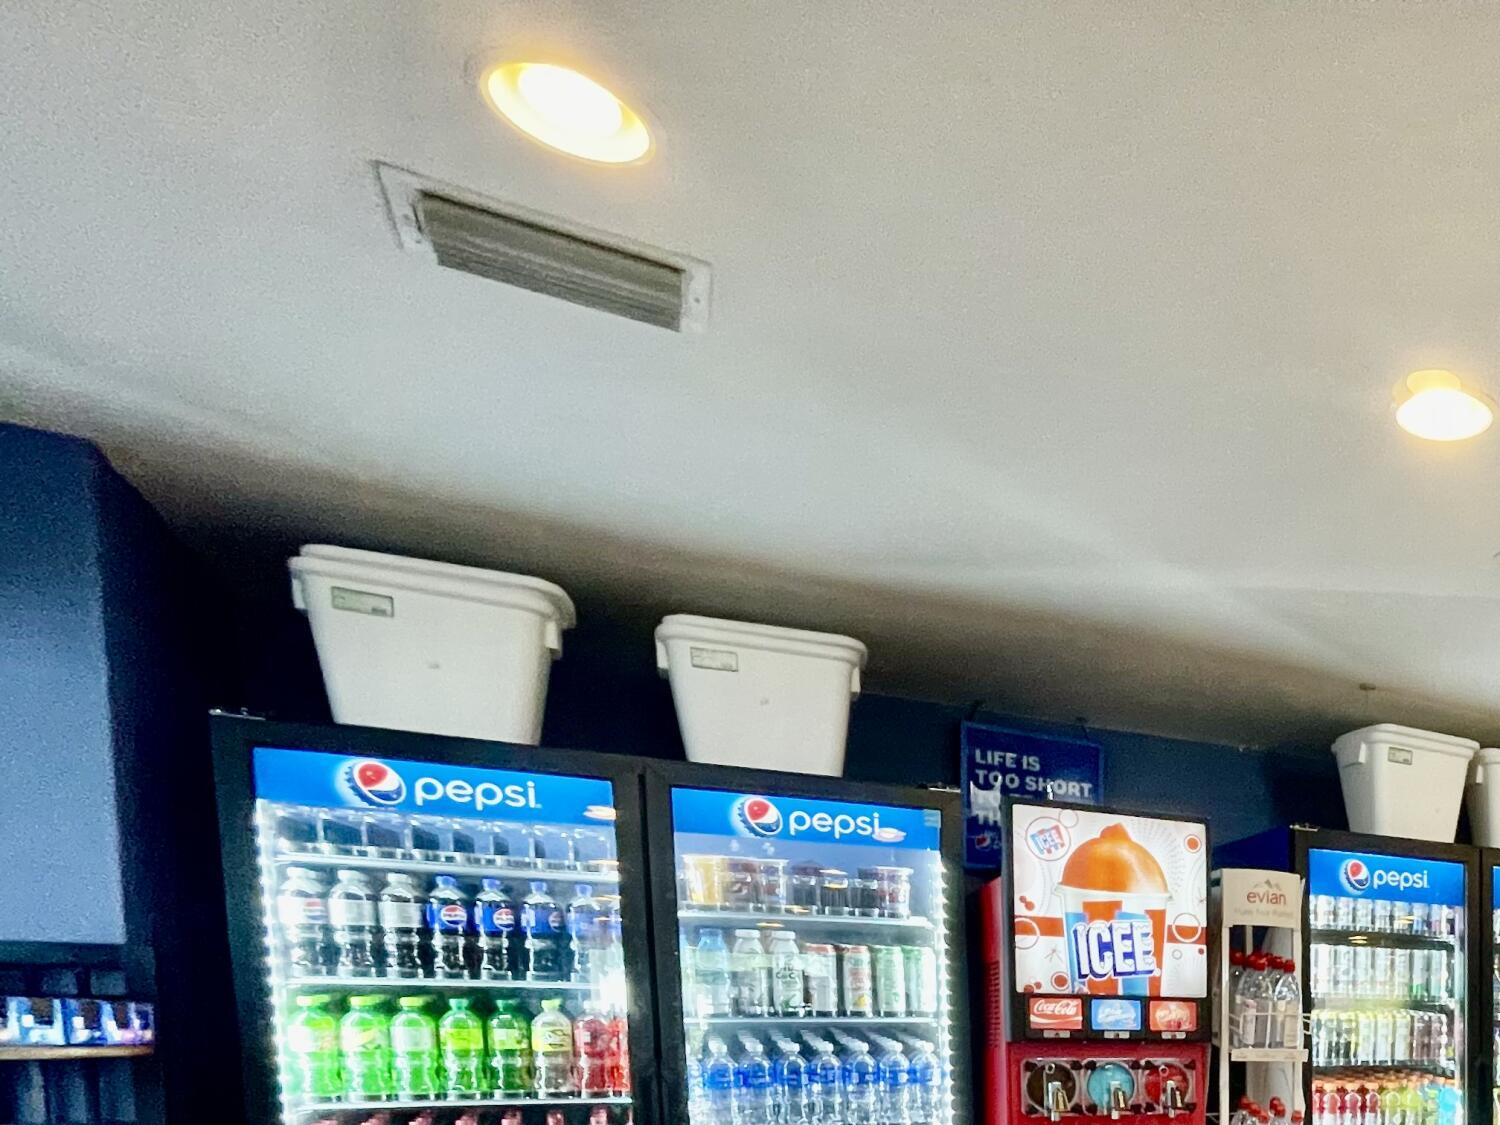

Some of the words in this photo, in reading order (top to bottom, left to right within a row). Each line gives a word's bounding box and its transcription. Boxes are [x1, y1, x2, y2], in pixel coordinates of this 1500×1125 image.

[975, 749, 1016, 769] LIFE
[1023, 752, 1040, 770] IS
[415, 777, 538, 810] pepsi
[976, 769, 1020, 788] TOO
[1025, 775, 1092, 798] SHORT
[789, 810, 881, 839] pepsi
[1373, 869, 1429, 891] pepsi
[1247, 889, 1287, 905] evian
[1072, 920, 1155, 980] ICEE
